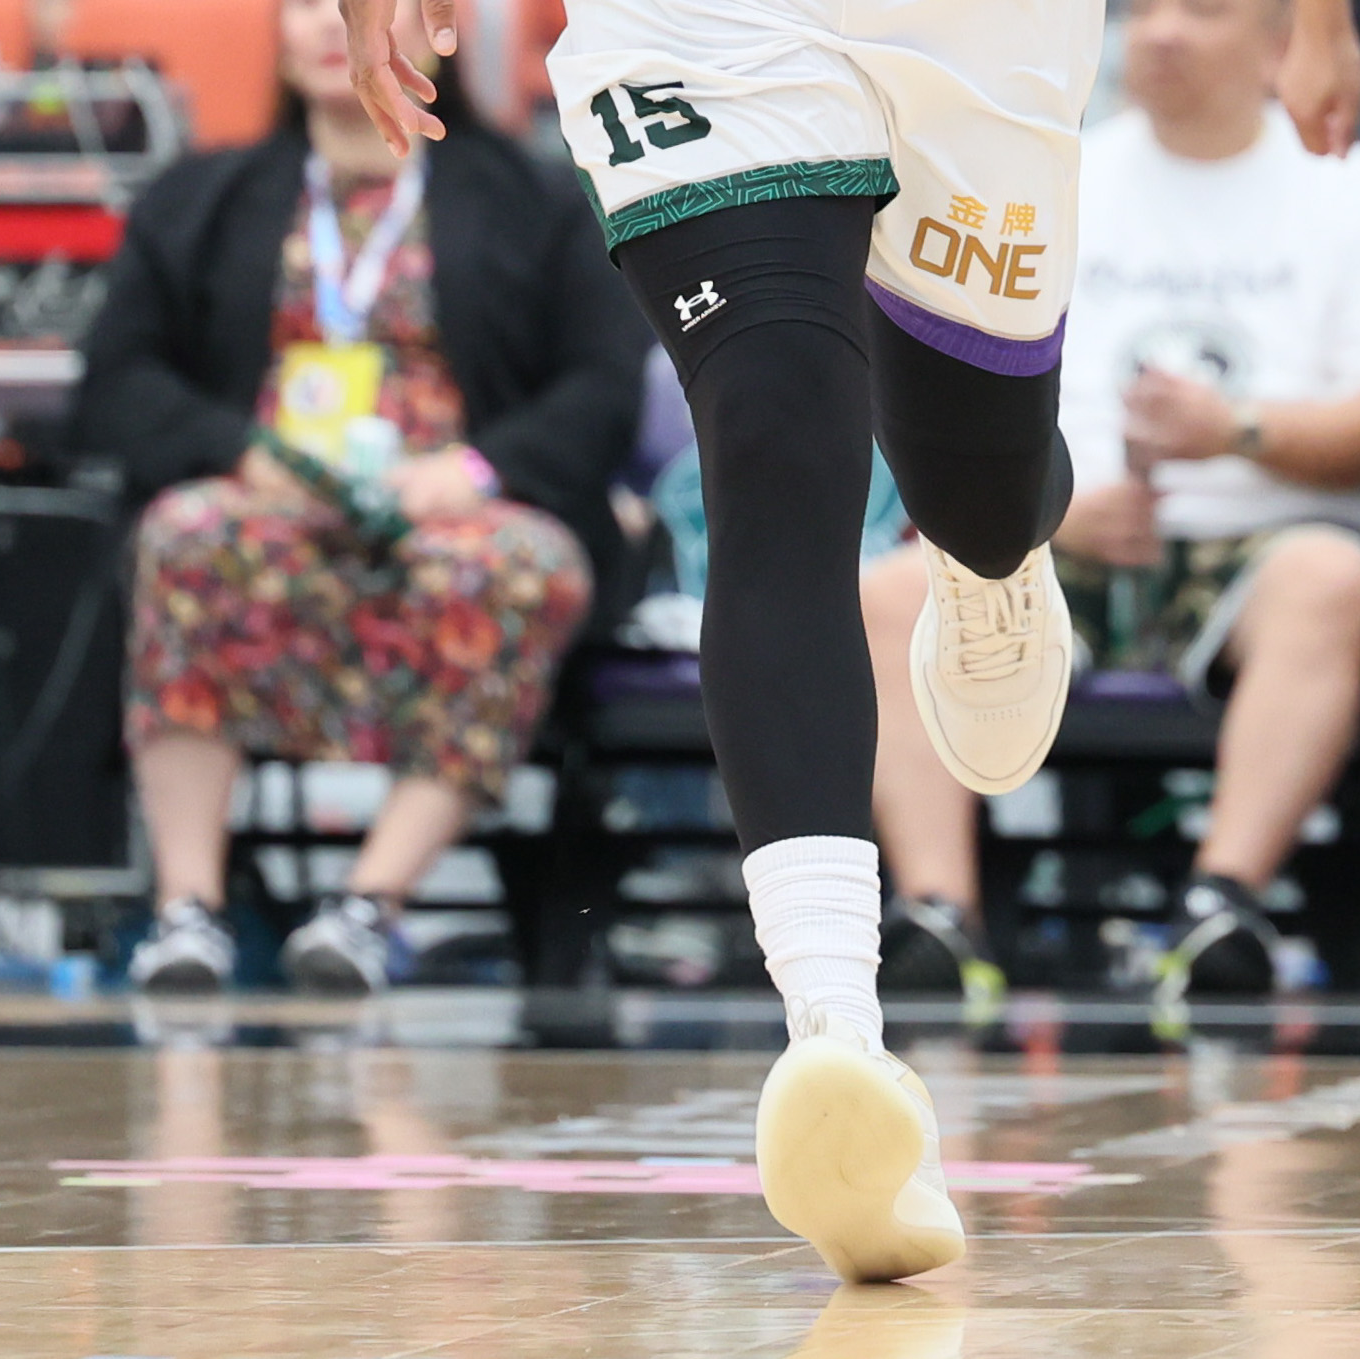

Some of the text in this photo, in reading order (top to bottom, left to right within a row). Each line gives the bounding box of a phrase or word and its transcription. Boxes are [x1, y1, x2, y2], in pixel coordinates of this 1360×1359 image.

[590, 81, 712, 167] 15
[947, 194, 1037, 237] 金牌
[909, 216, 1048, 300] ONE
